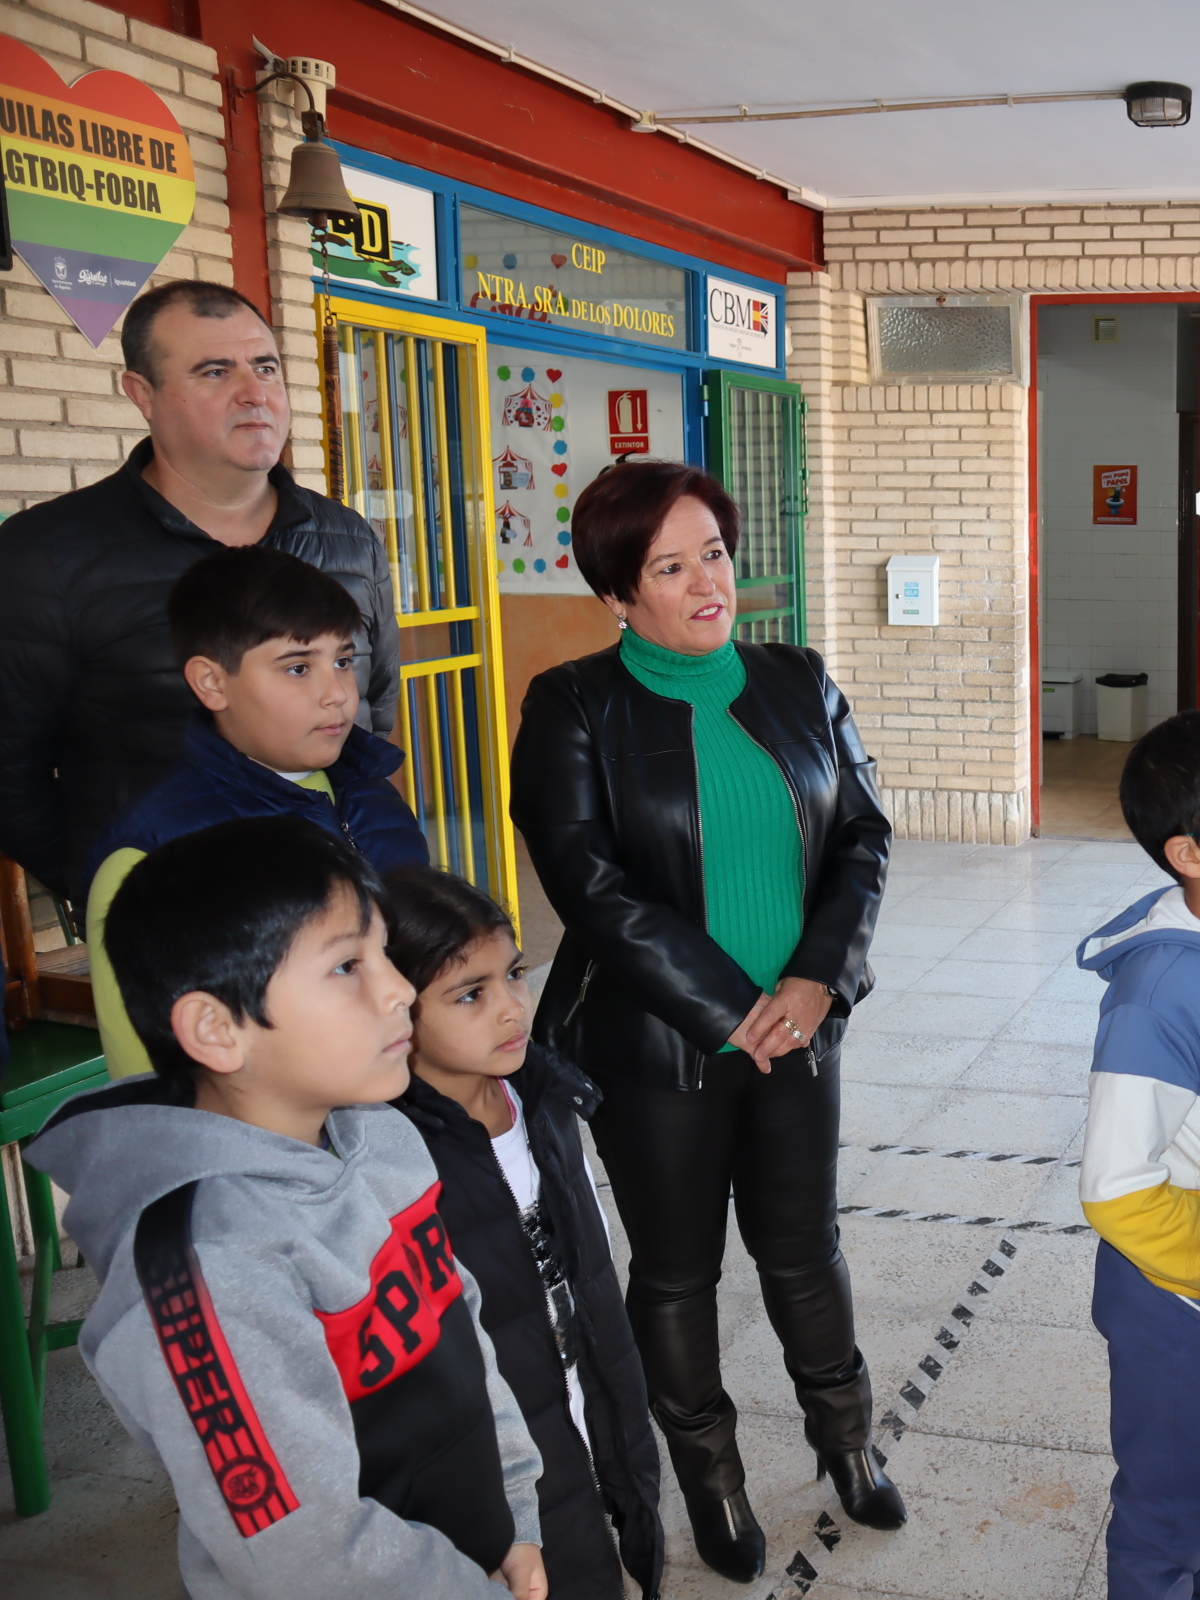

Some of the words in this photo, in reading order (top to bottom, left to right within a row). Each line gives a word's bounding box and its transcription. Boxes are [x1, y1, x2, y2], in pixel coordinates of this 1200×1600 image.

[79, 118, 146, 166] LIBRE
[149, 137, 177, 174] DE
[3, 148, 162, 214] GTBIQ-FOBIA
[571, 242, 607, 274] CEIP
[476, 271, 533, 310] NTRA.
[533, 285, 570, 317] SRA.
[571, 298, 588, 321] DE
[589, 303, 611, 326] LOS
[613, 303, 676, 338] DOLORES
[709, 288, 752, 330] CBM
[614, 440, 645, 449] EXTINTOR
